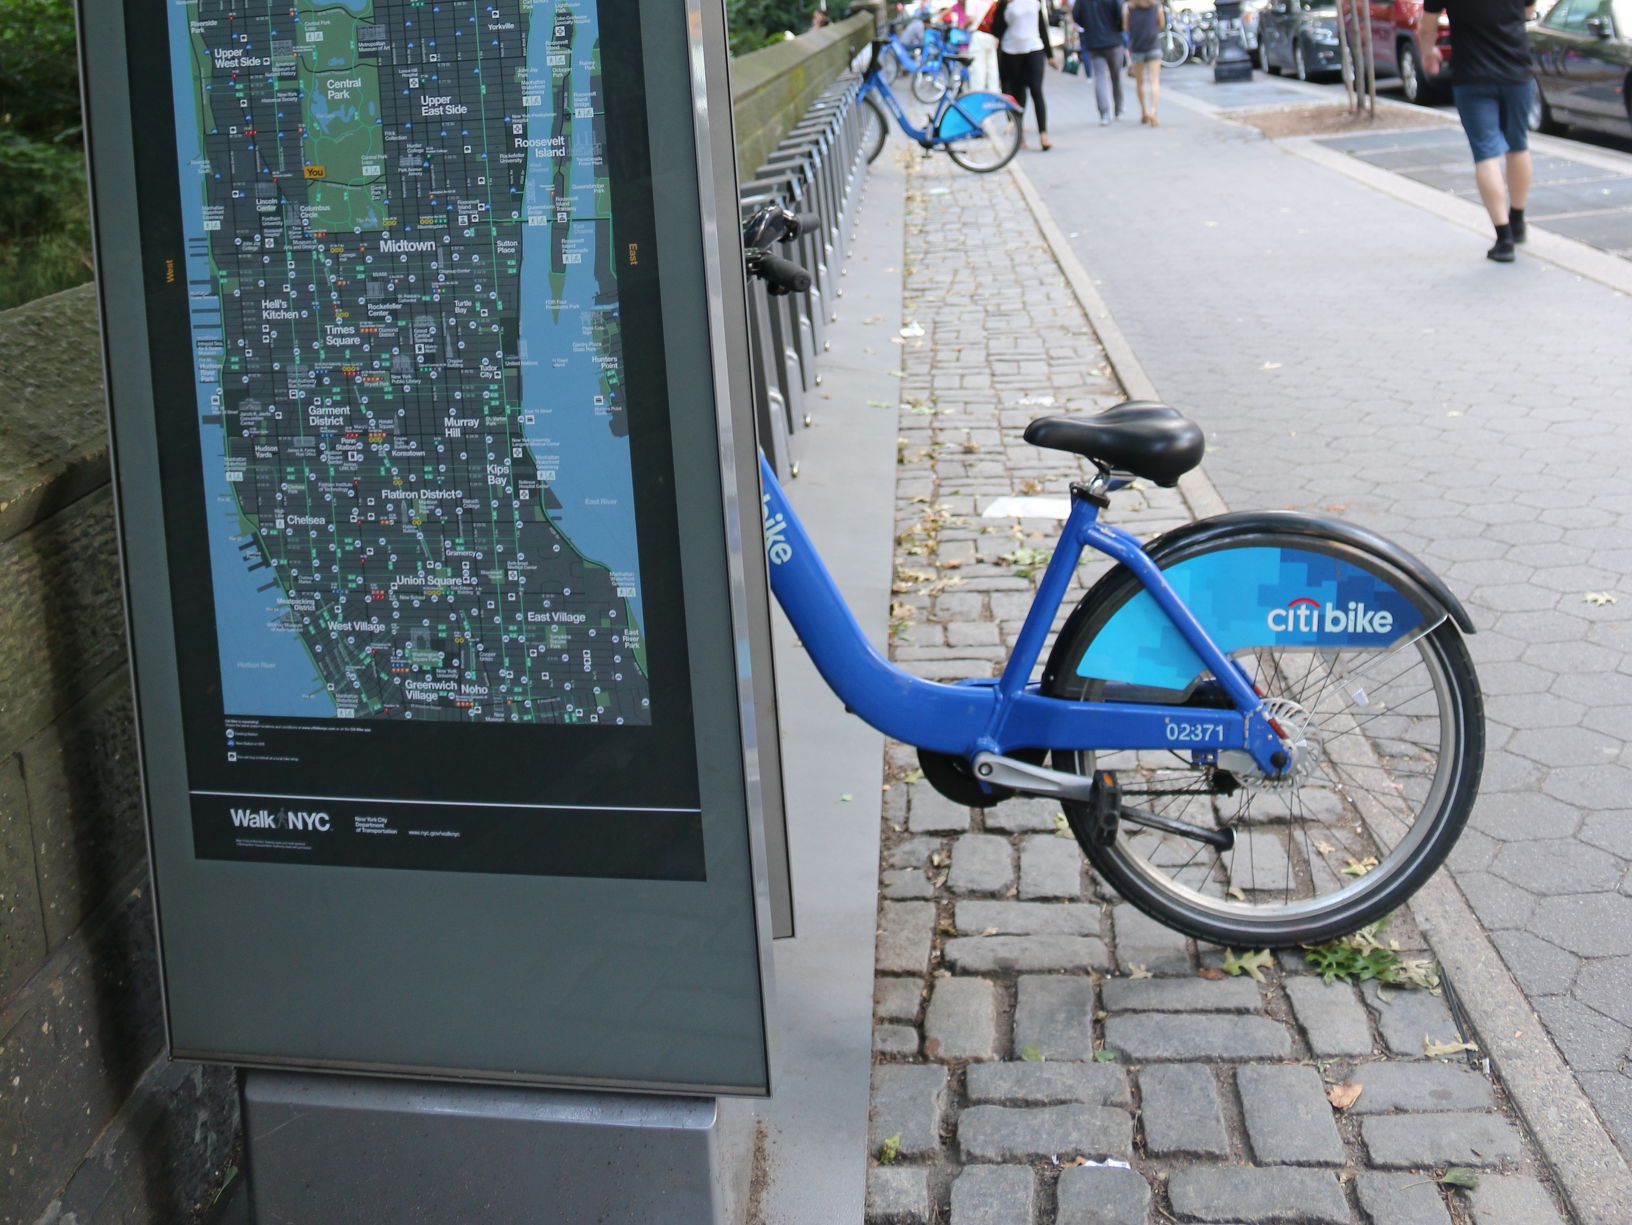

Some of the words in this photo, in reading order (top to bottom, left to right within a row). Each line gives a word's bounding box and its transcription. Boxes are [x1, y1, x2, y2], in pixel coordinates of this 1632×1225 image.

[215, 49, 243, 58] Upper
[215, 58, 238, 68] West
[240, 57, 260, 67] Side
[327, 78, 361, 89] Central
[328, 90, 350, 100] Park
[421, 96, 451, 106] Upper
[422, 106, 442, 116] East
[445, 105, 467, 114] Side
[515, 136, 565, 148] Roosevelt
[536, 148, 565, 157] Island
[307, 168, 323, 177] You
[380, 240, 435, 252] Midtown
[629, 243, 637, 266] East
[166, 260, 174, 283] West
[262, 300, 287, 309] Hell's
[263, 309, 298, 319] Kitchen
[325, 325, 355, 334] Times
[326, 336, 360, 346] Square
[309, 406, 350, 416] Garment
[310, 416, 344, 426] District
[444, 418, 479, 428] Murray
[446, 429, 460, 438] Hill
[487, 465, 509, 475] Kips
[488, 475, 507, 485] Bay
[382, 490, 418, 499] Flatiron
[421, 490, 456, 499] District
[287, 515, 325, 525] Chelsea
[397, 576, 422, 585] Union
[428, 577, 462, 586] Square
[528, 612, 550, 622] East
[552, 612, 586, 623] Village
[1267, 598, 1320, 633] citi
[1324, 601, 1393, 634] bike
[328, 621, 351, 631] West
[352, 621, 385, 632] Village
[405, 679, 457, 690] Greenwich
[461, 684, 488, 694] Noho
[406, 691, 438, 701] Village
[1166, 723, 1225, 742] 02371
[230, 809, 275, 828] Walk
[287, 811, 330, 831] NYC
